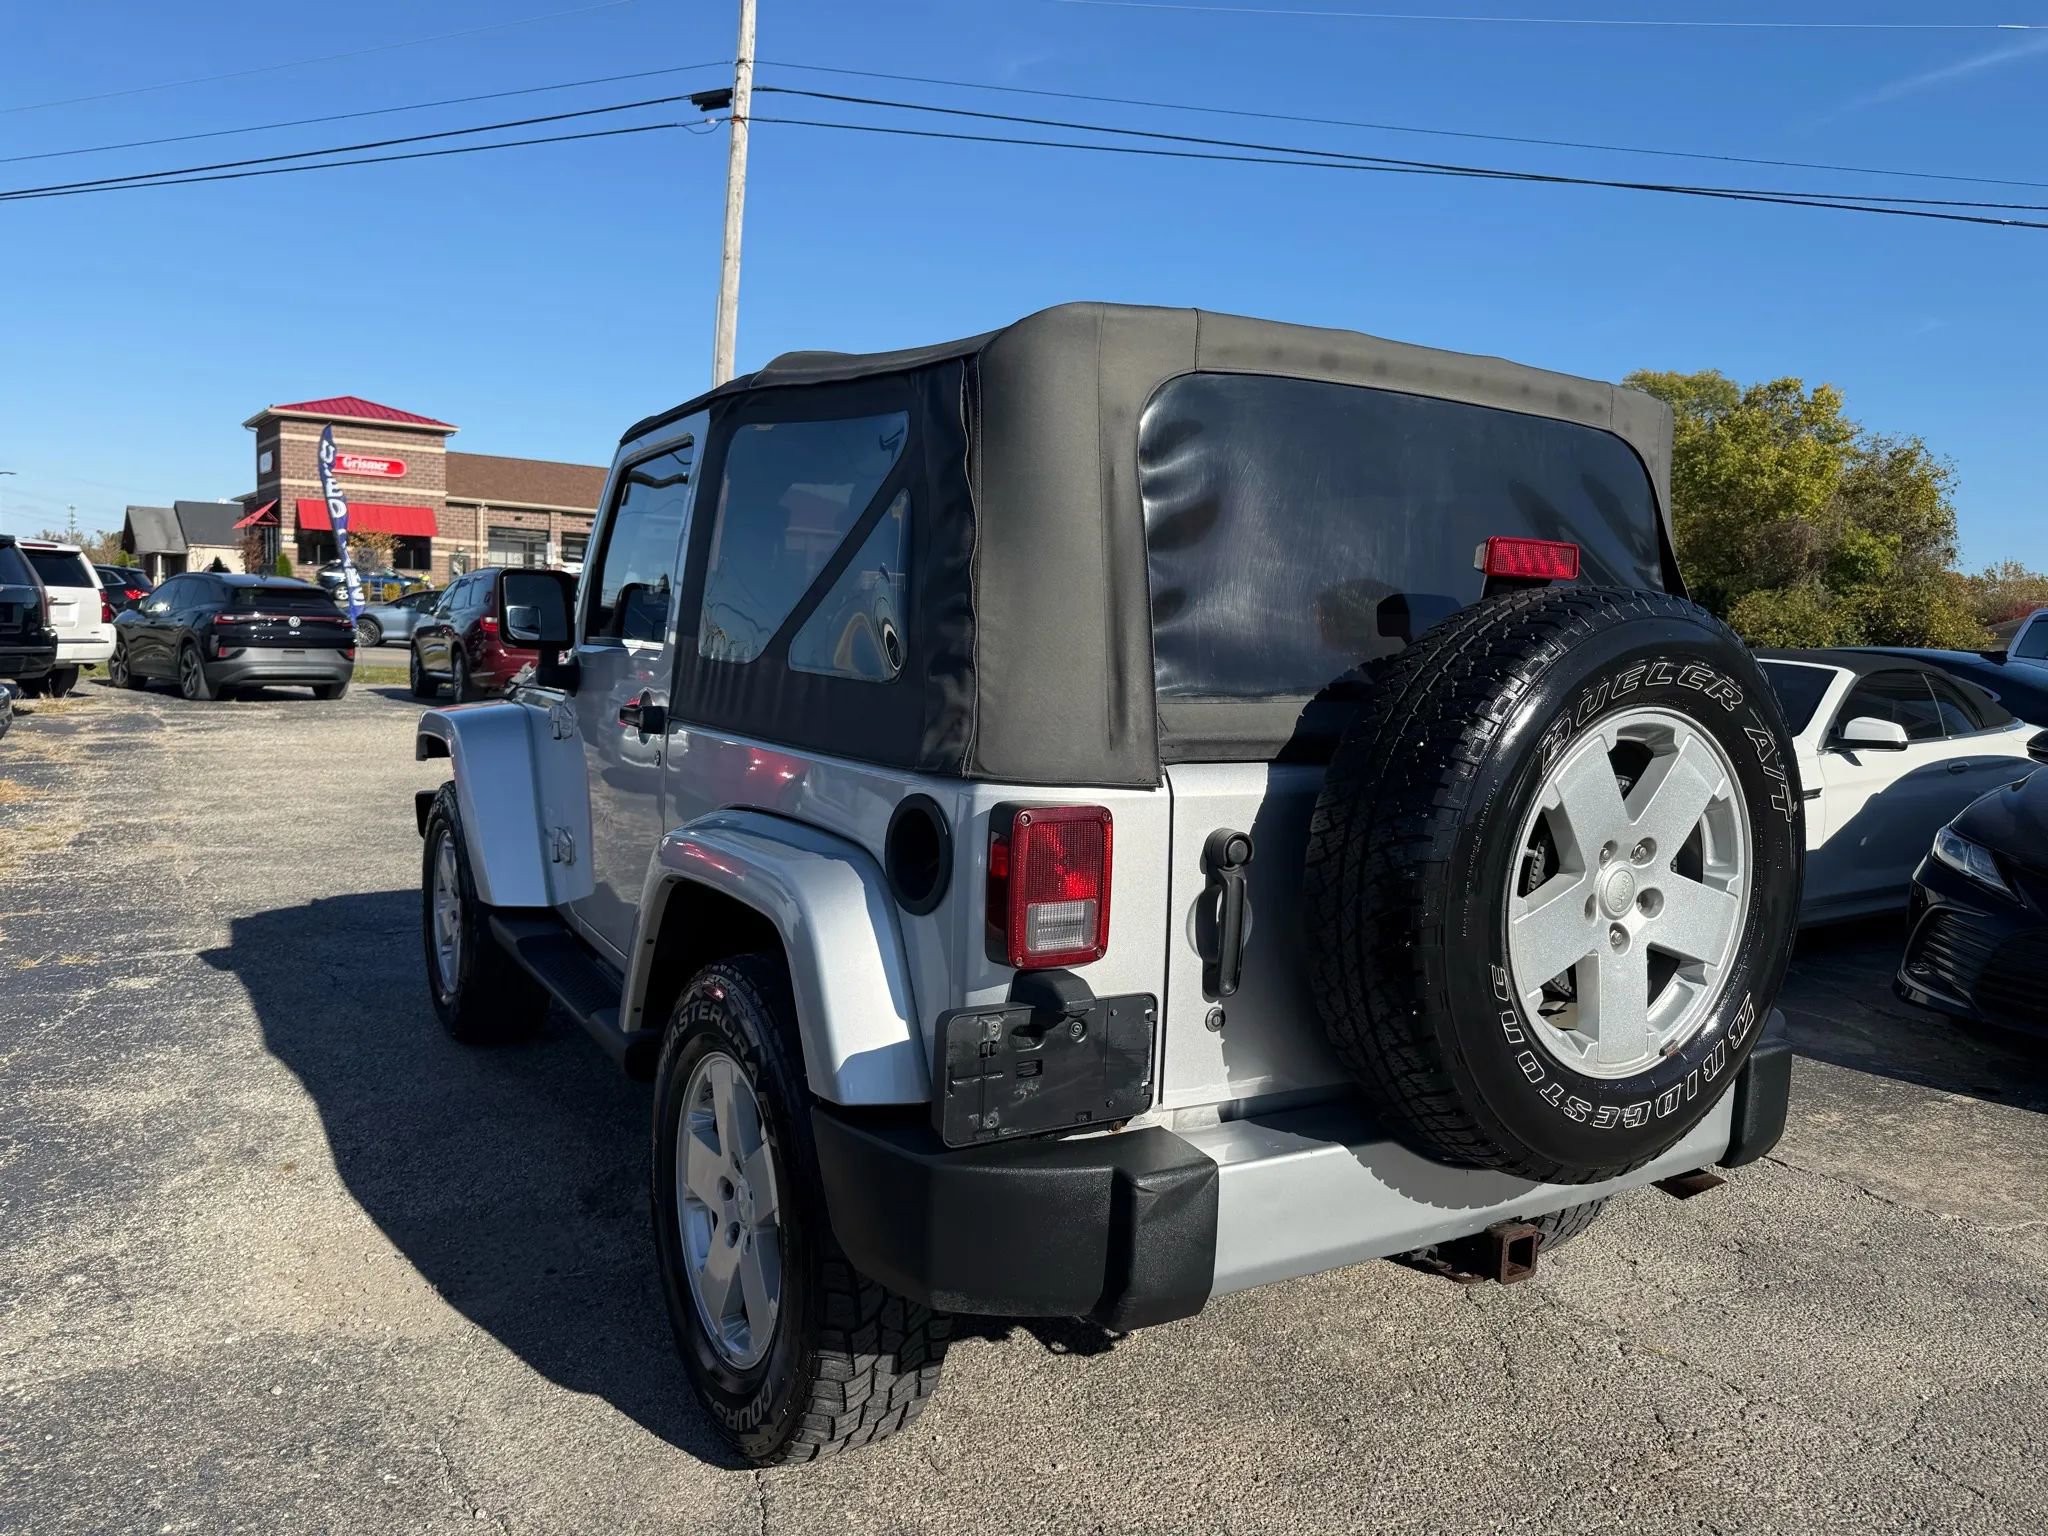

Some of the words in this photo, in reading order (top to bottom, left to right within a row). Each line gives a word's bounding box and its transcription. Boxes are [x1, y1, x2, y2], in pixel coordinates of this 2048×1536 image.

[342, 455, 390, 471] Grismer
[1542, 662, 1744, 775] DUELER
[1744, 727, 1792, 822] A/T
[1490, 963, 1755, 1129] BRIDGESTONE
